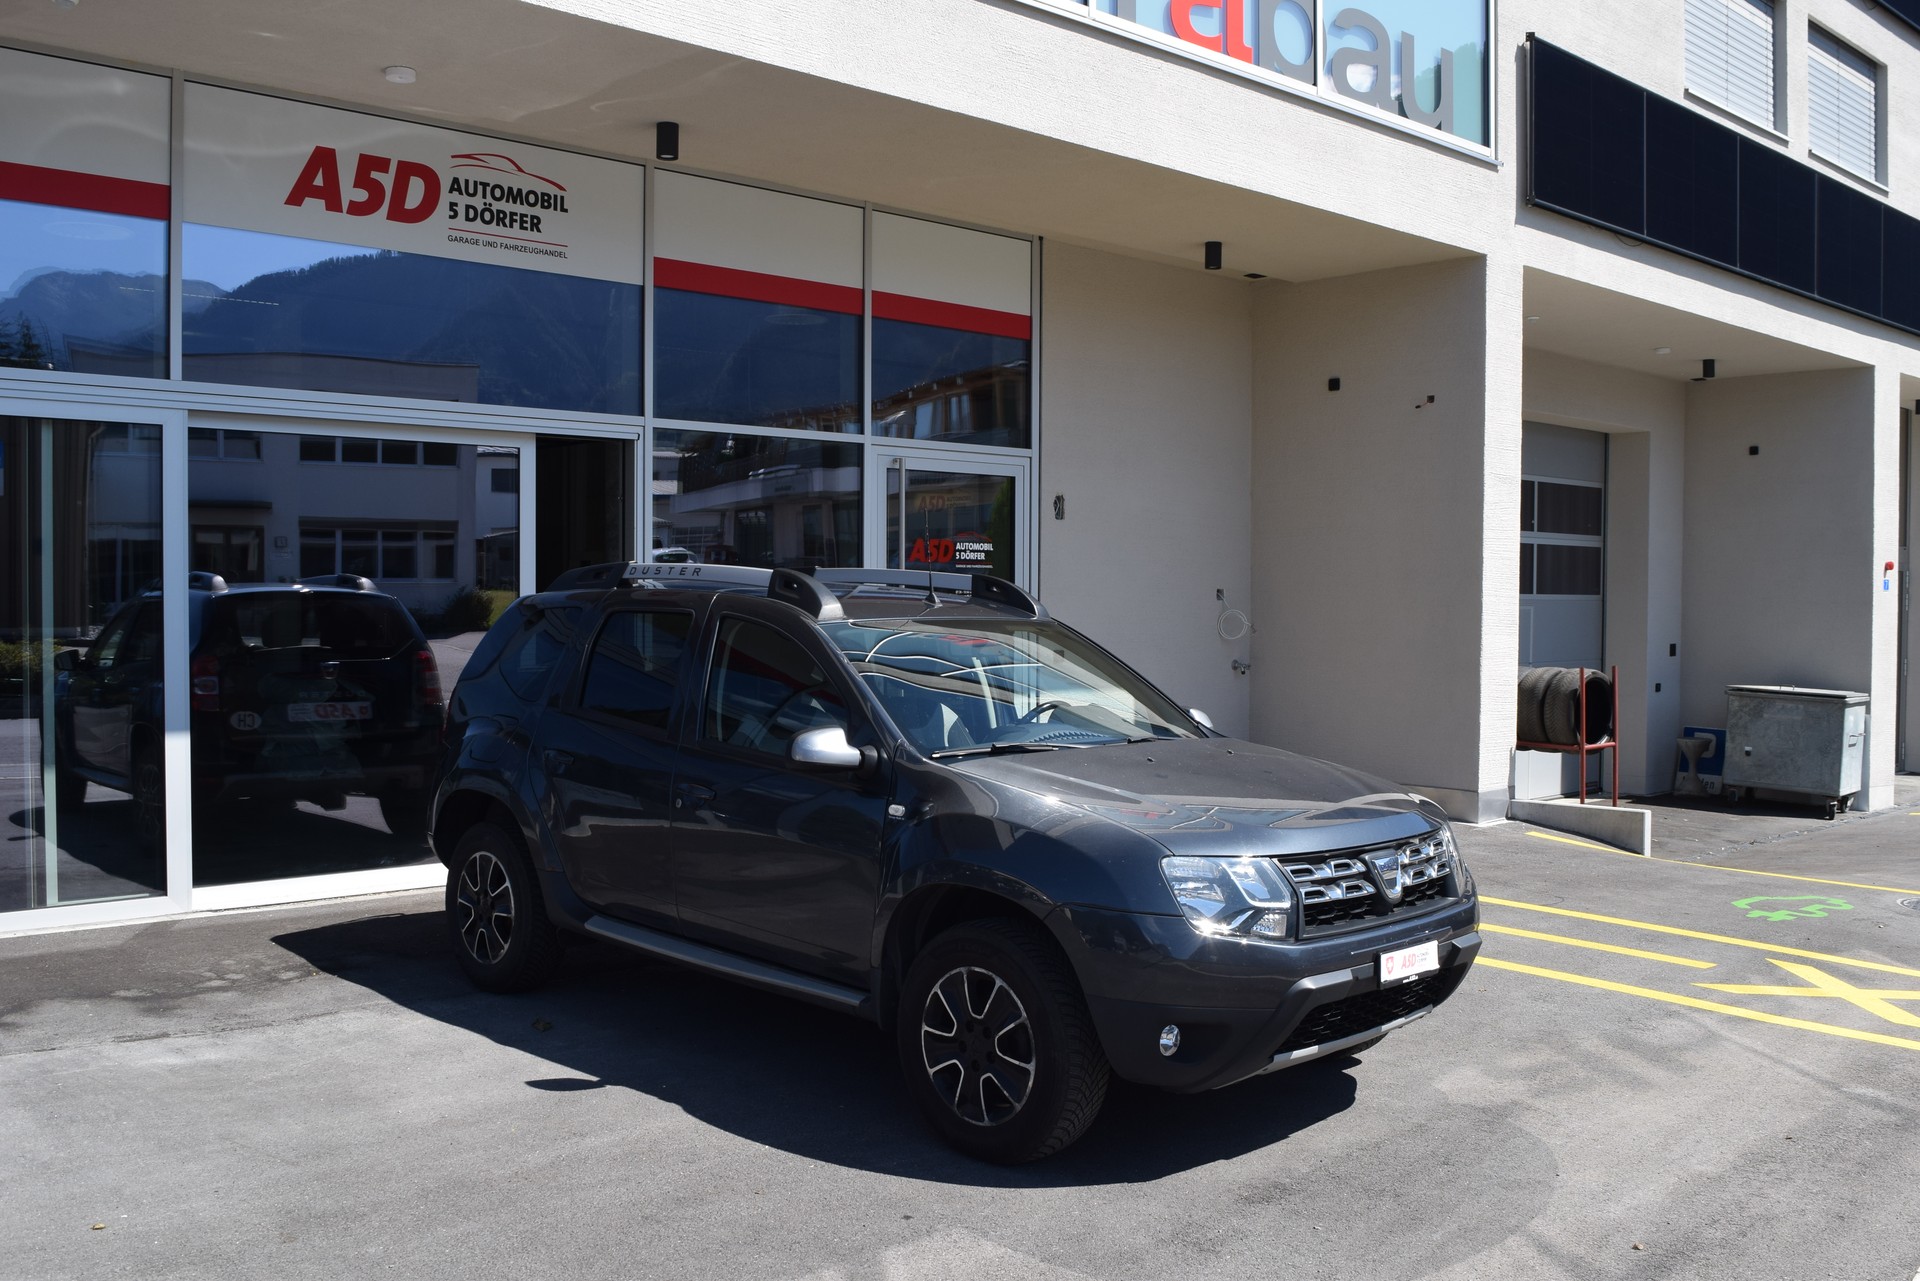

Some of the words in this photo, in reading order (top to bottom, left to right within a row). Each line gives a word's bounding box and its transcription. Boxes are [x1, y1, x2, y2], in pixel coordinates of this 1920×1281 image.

[284, 145, 442, 224] A5D
[447, 177, 569, 213] AUTOMOBIL
[448, 202, 459, 219] 5
[464, 202, 542, 233] DÖRFER
[447, 234, 481, 248] GARAGE
[482, 239, 498, 249] UND
[499, 241, 568, 259] FAHRZEUGHANDEL
[909, 537, 955, 563] A5D
[956, 542, 993, 551] AUTOMOBIL
[961, 550, 985, 560] DÖRFER
[628, 566, 702, 576] DUSTER
